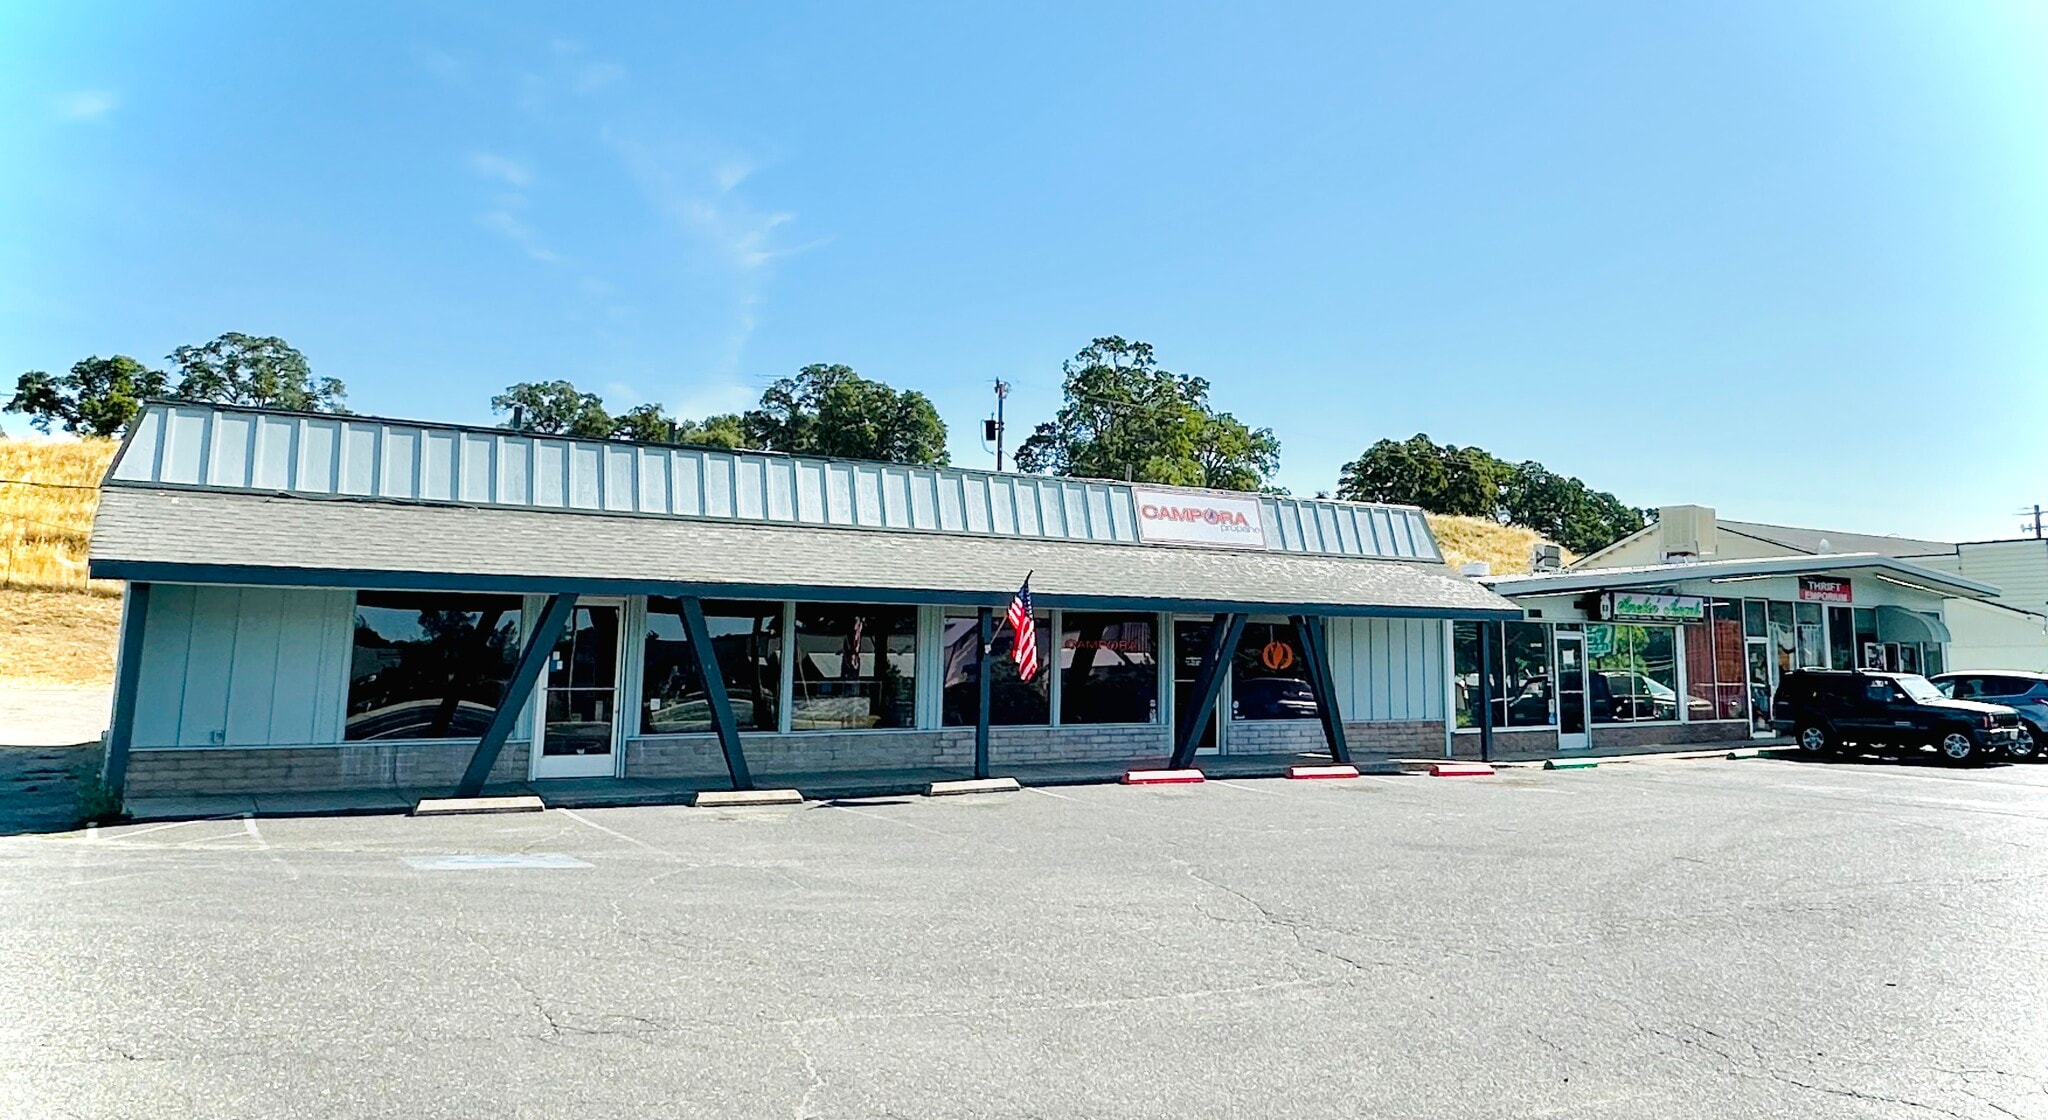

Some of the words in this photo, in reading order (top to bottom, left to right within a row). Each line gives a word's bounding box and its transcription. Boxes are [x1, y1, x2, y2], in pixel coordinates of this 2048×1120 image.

[1142, 504, 1250, 527] CAMPORA
[1808, 581, 1841, 592] THRIFT
[1804, 590, 1848, 602] EMPORIUM
[1065, 640, 1137, 650] CAMPORA
